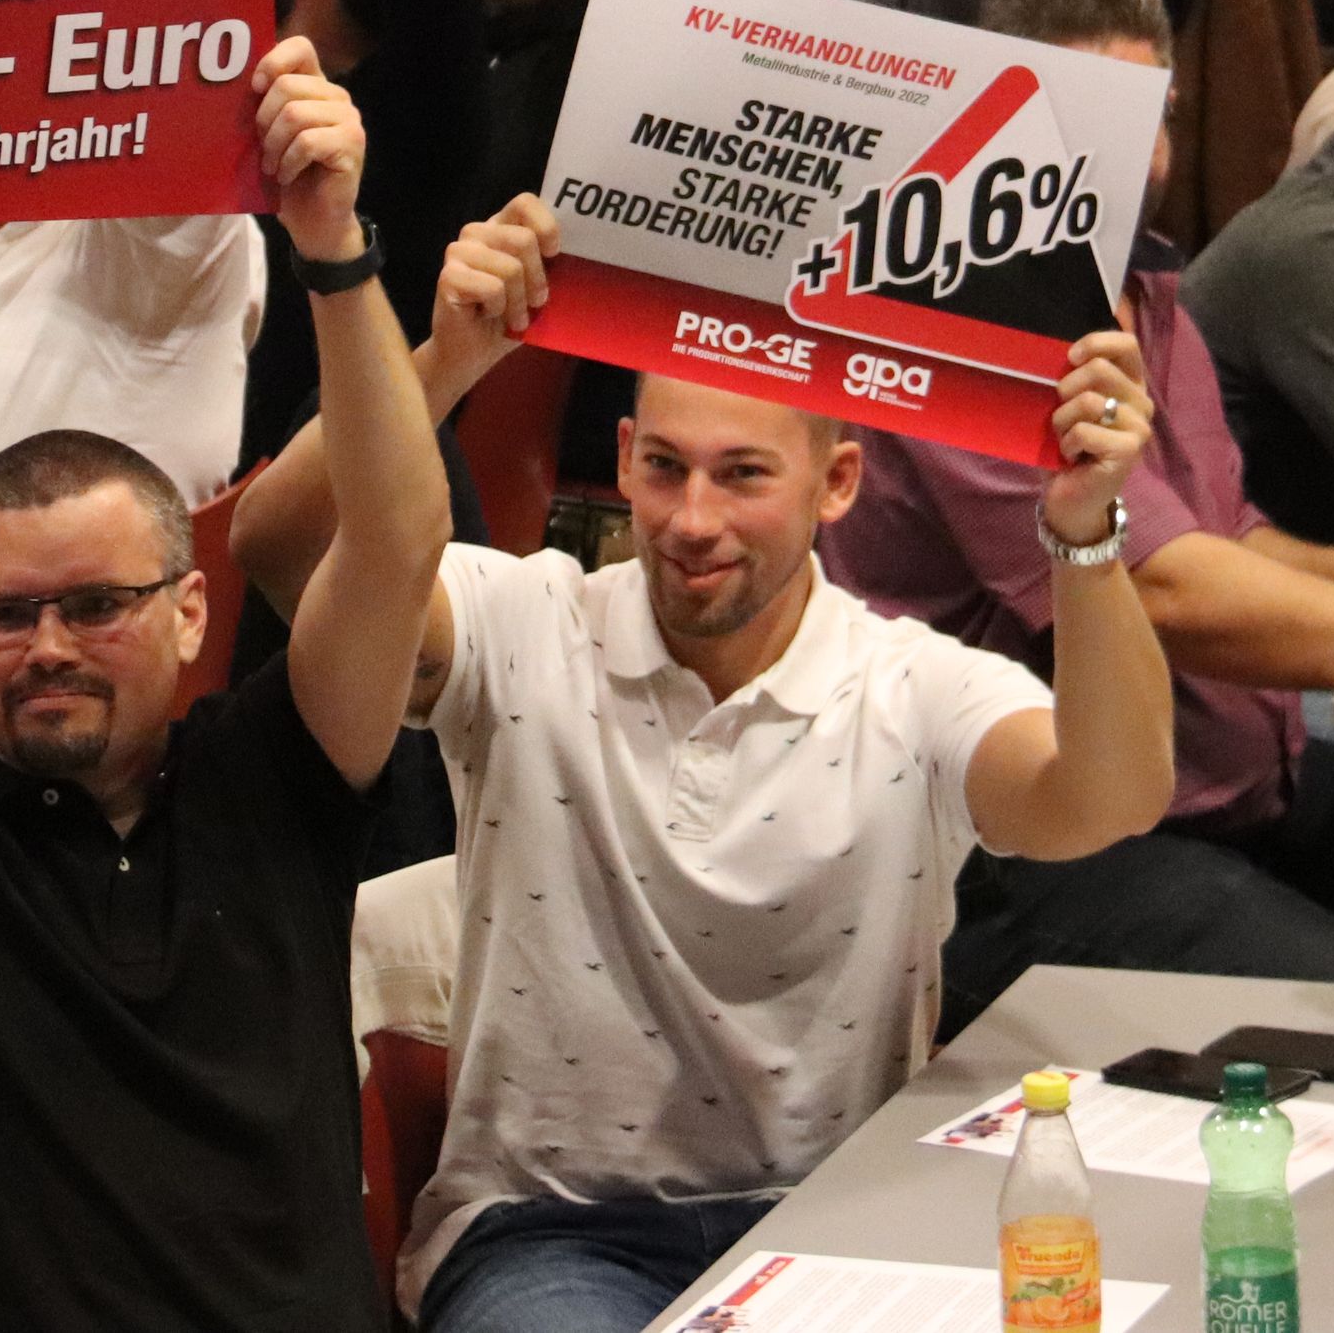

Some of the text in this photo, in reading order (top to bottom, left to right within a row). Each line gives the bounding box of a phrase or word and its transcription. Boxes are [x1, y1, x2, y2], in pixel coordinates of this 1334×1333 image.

[46, 12, 251, 96] Euro
[684, 5, 957, 90] KV-VERHANDLUNGEN
[742, 52, 930, 107] Metallindustrie & Bergbau 2022
[629, 113, 844, 200] MENSCHEN,
[735, 98, 884, 161] STARKE
[553, 178, 785, 262] FORDERUNG!
[672, 167, 818, 230] STARKE
[797, 154, 1099, 292] +10,6%
[671, 343, 811, 384] DIE PRODUKTIONSGEWERKSCHAFT
[674, 311, 932, 400] PRO-GE gpa
